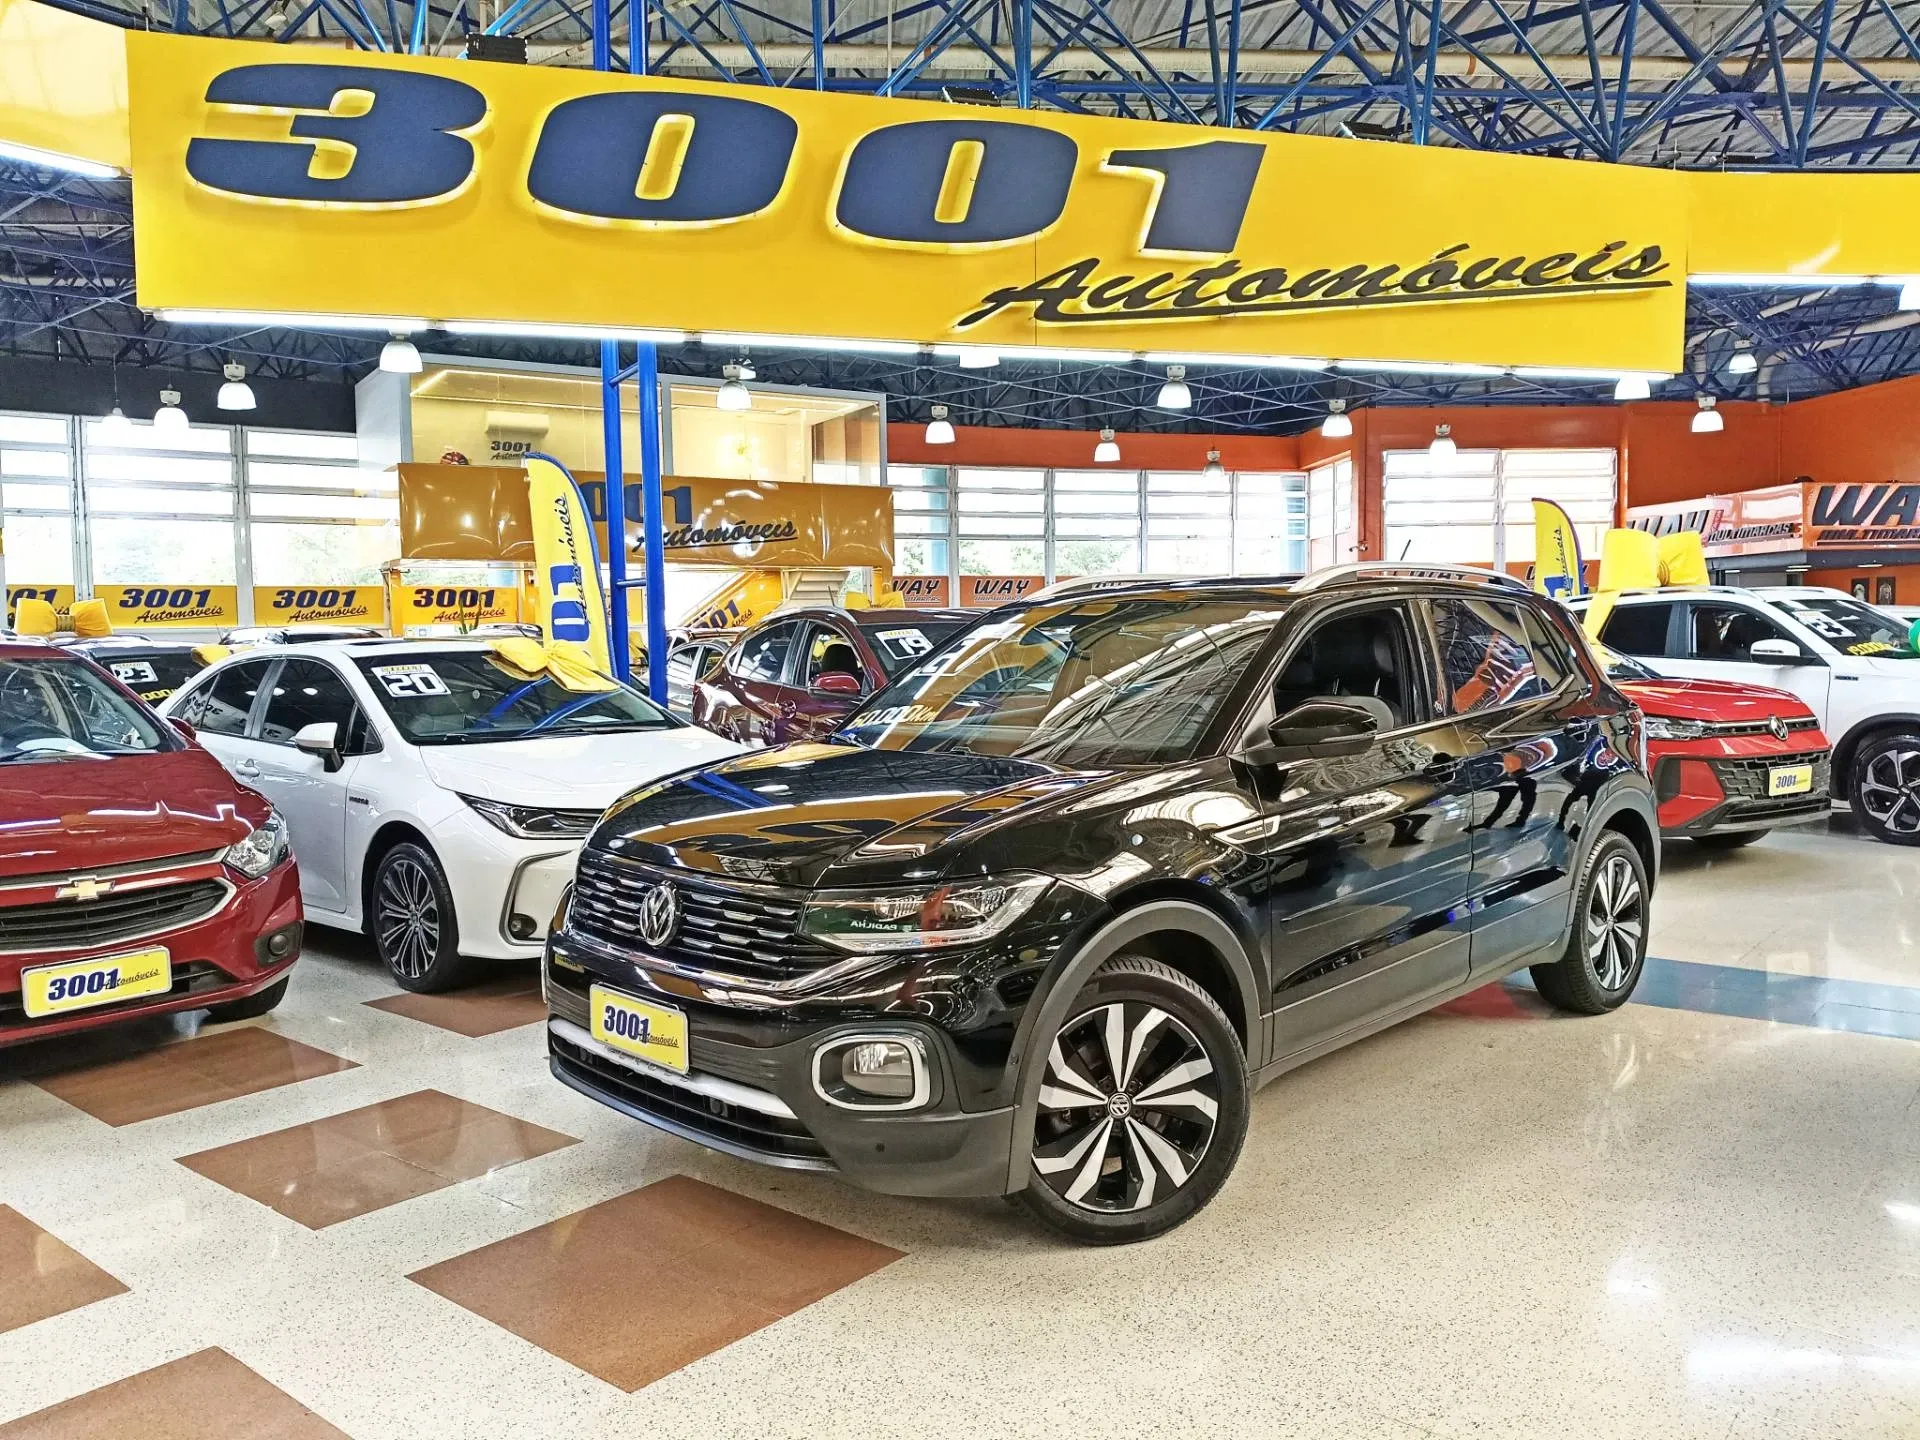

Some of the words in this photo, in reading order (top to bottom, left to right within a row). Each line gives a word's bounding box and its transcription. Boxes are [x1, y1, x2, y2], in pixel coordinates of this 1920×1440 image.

[185, 63, 1267, 255] 3001
[954, 241, 1673, 327] Automóveis
[490, 440, 532, 453] 3001
[632, 519, 799, 553] utomóveis
[974, 579, 1030, 595] WAY
[118, 588, 211, 609] 3001
[272, 589, 357, 609] 3001
[413, 588, 495, 608] 3001
[134, 605, 225, 624] Automóveis
[287, 604, 370, 623] Automóveis
[381, 673, 448, 696] 20
[1775, 774, 1797, 789] 3001
[48, 967, 119, 1001] 3001
[603, 1005, 650, 1045] 3001
